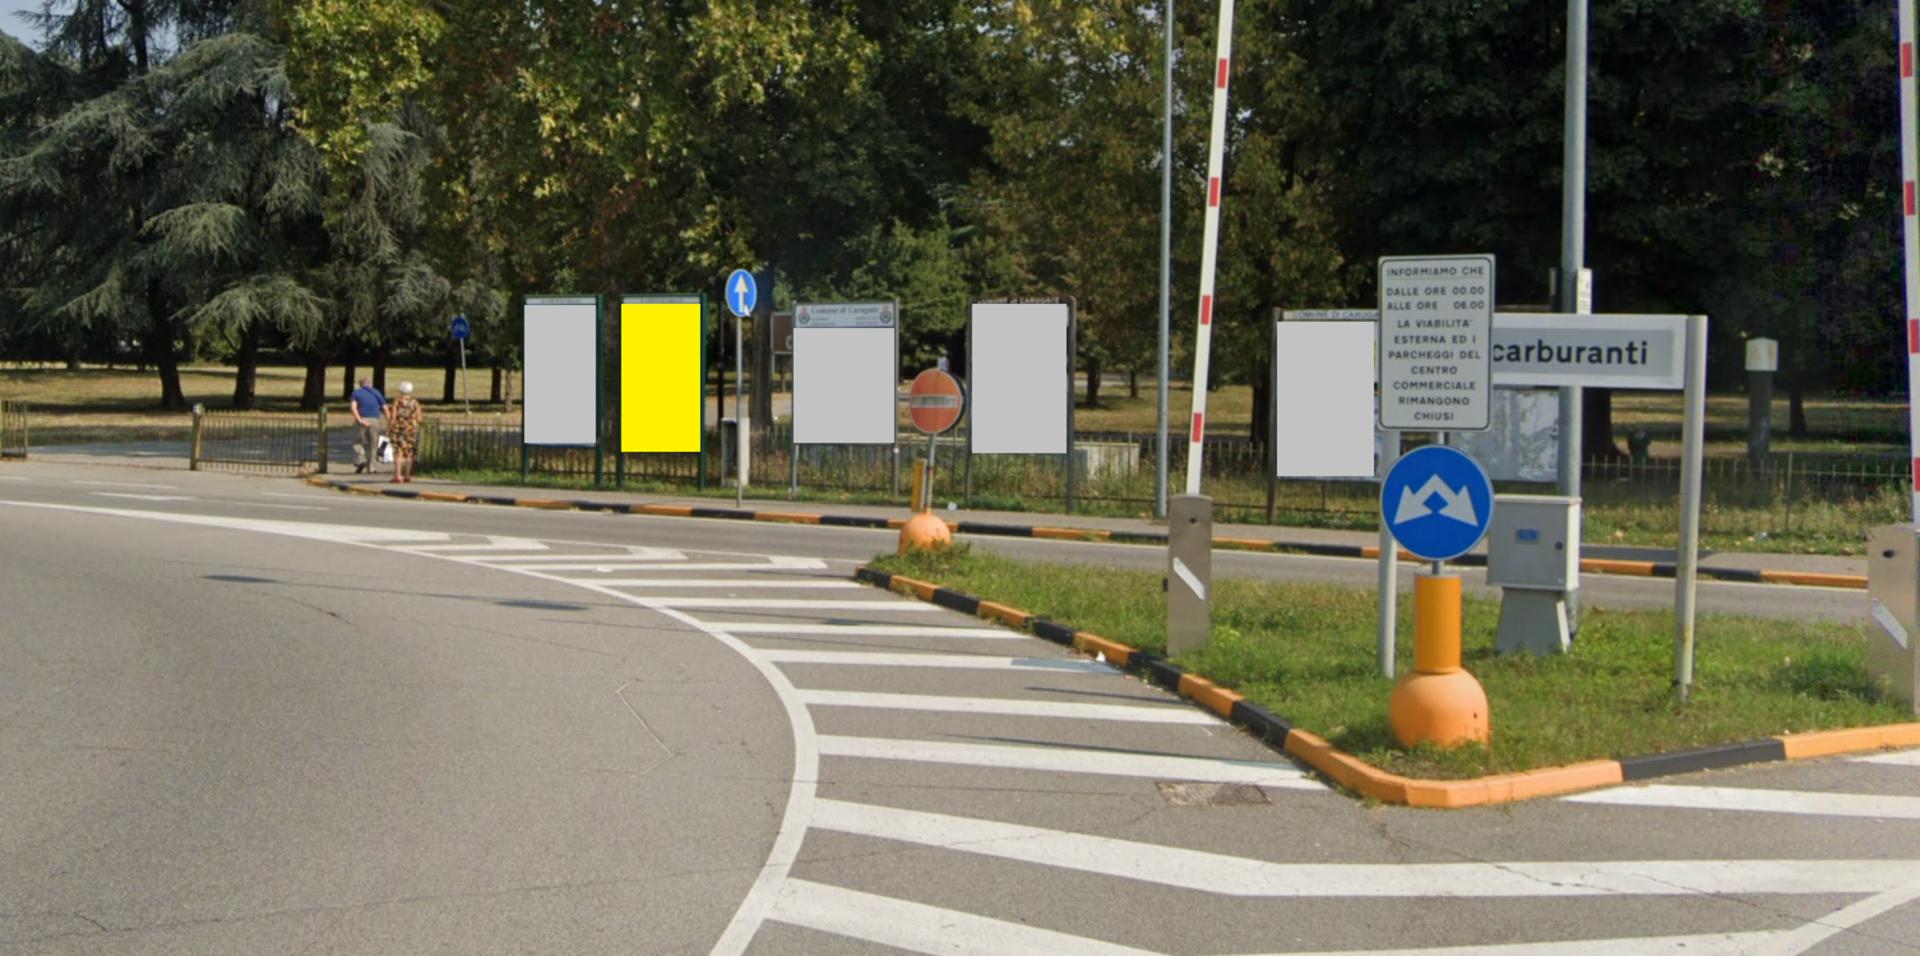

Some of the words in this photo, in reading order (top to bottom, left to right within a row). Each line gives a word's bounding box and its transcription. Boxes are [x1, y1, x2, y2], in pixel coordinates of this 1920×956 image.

[1386, 266, 1457, 277] INFORMIAMO
[1462, 266, 1484, 275] CHE
[1386, 287, 1419, 296] DALLE
[1424, 286, 1446, 296] ORE
[1452, 286, 1485, 295] 00.00
[1386, 302, 1411, 310] ALLE
[1417, 301, 1438, 310] ORE
[1453, 301, 1485, 310] 06.00
[1292, 310, 1328, 319] COMUNE
[1331, 310, 1341, 319] DI
[1342, 310, 1380, 319] CARUGA
[1397, 319, 1410, 328] LA
[1394, 335, 1446, 344] ESTERNA
[1452, 335, 1467, 344] ED
[1472, 335, 1476, 343] I
[1388, 350, 1454, 359] PARCHEGGI
[1459, 351, 1480, 359] DEL
[1493, 339, 1648, 365] carburanti
[1410, 366, 1458, 375] CENTRO
[1393, 381, 1476, 390] COMMERCIALE
[1398, 396, 1470, 405] RIMANGONO
[1414, 411, 1454, 421] CHIUSI
